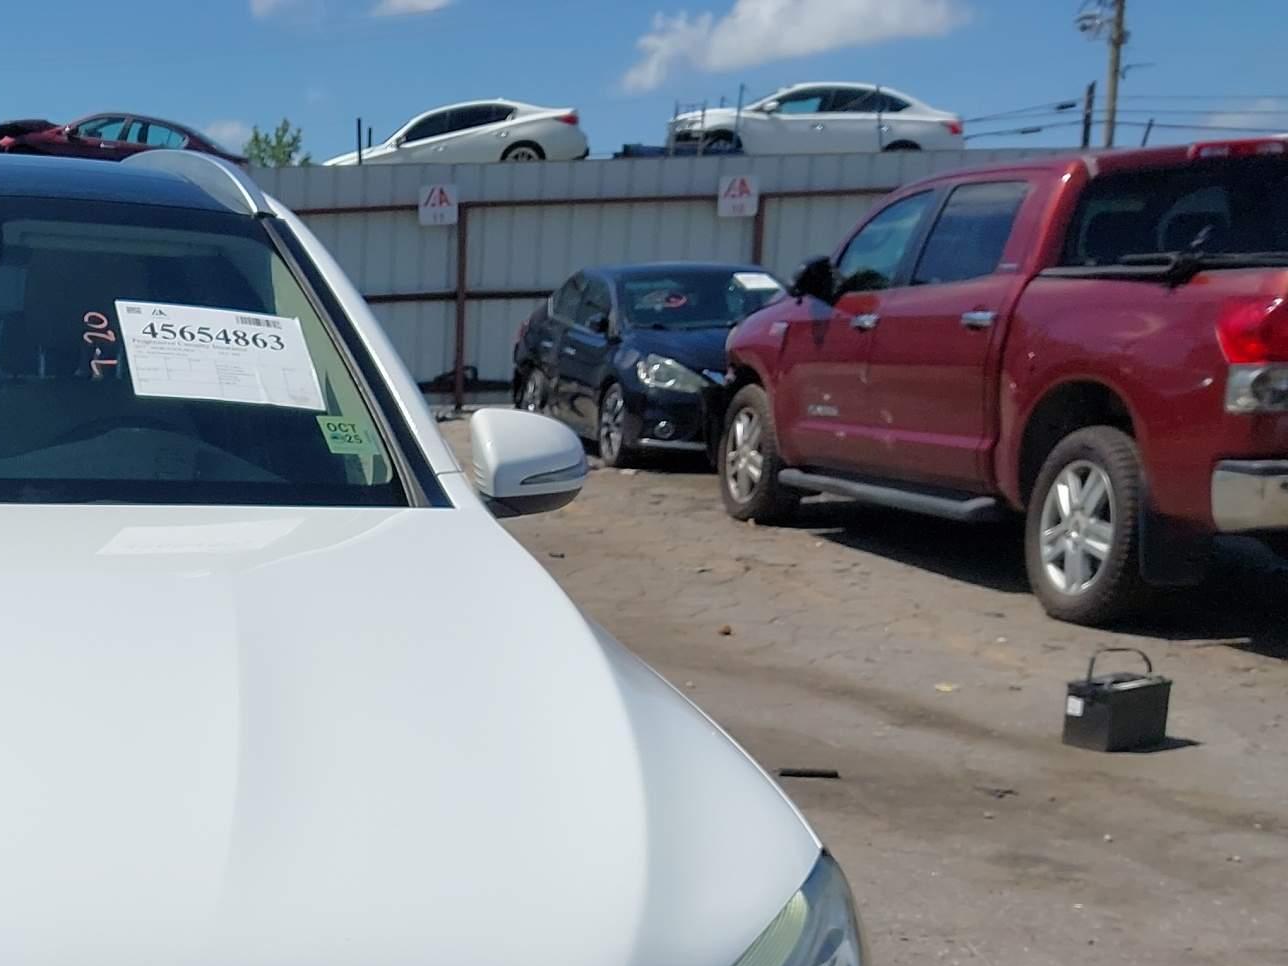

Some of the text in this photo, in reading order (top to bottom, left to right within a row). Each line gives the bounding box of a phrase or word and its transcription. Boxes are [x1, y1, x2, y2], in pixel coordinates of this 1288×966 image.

[142, 321, 286, 352] 45654863
[327, 422, 357, 434] OCT
[345, 434, 362, 444] 25
